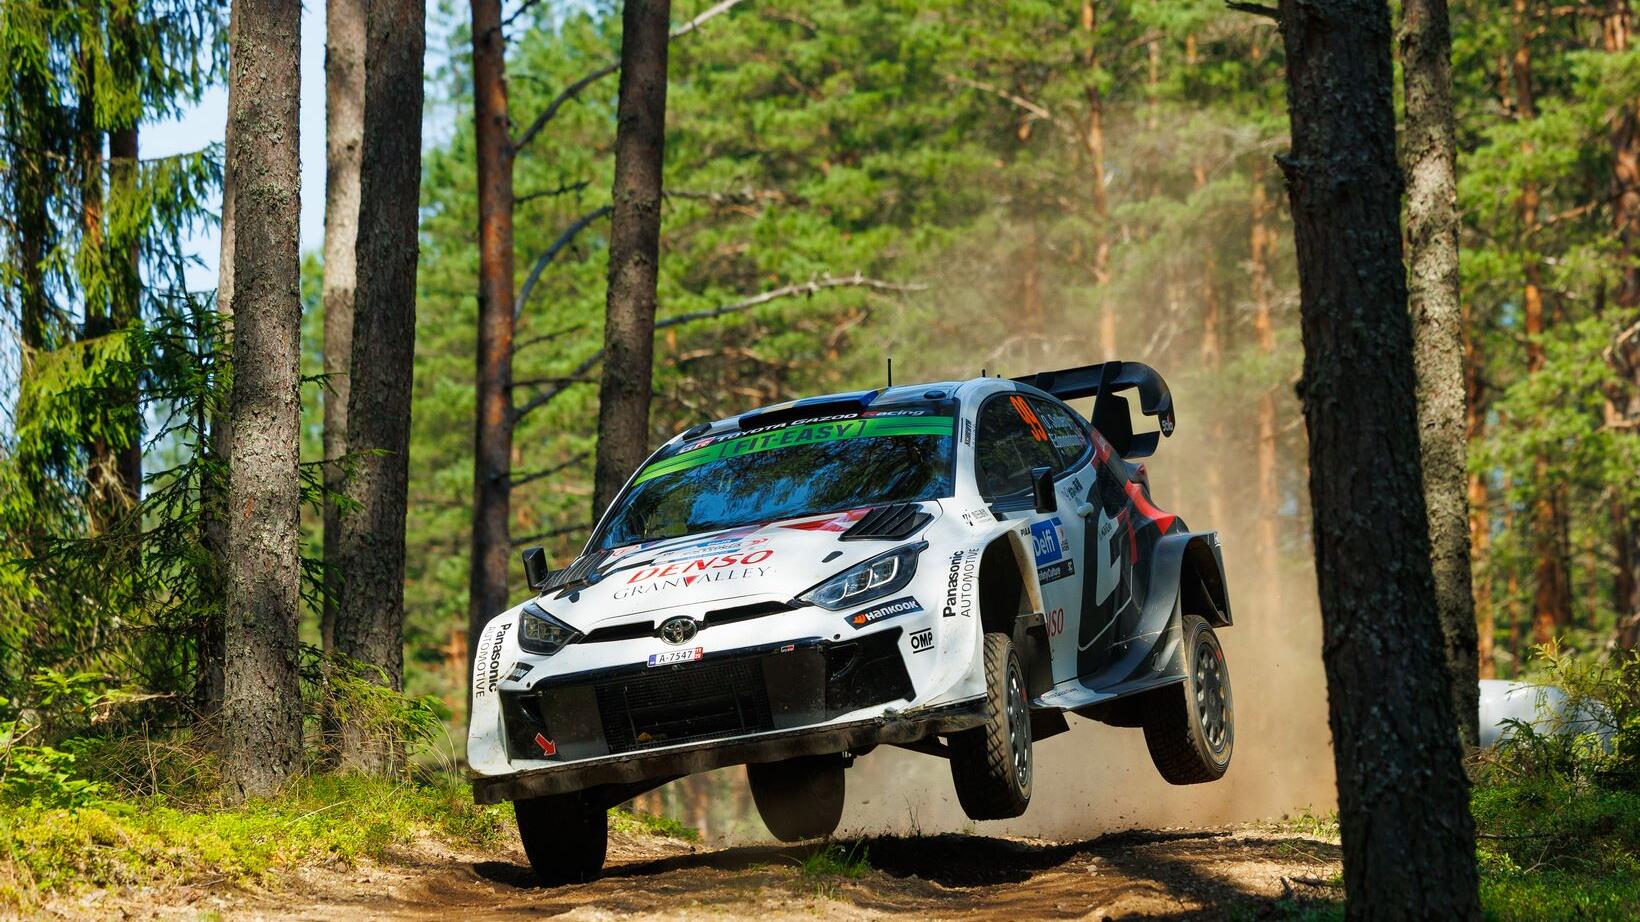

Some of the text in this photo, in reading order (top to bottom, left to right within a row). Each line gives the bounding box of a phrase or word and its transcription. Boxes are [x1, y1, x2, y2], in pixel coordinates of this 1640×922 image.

[714, 422, 787, 442] TOYOTA
[790, 412, 858, 426] GAZOO
[860, 409, 926, 418] Racing
[1009, 395, 1049, 442] 99
[1032, 528, 1056, 558] Delfi
[626, 549, 774, 584] DENSO
[942, 549, 964, 618] Panasonic
[960, 547, 980, 618] AUTOMOTIVE
[488, 622, 513, 694] Panasonic
[658, 650, 693, 663] A-7547
[910, 631, 933, 650] OMP
[475, 625, 497, 699] AUTOMOTIVE
